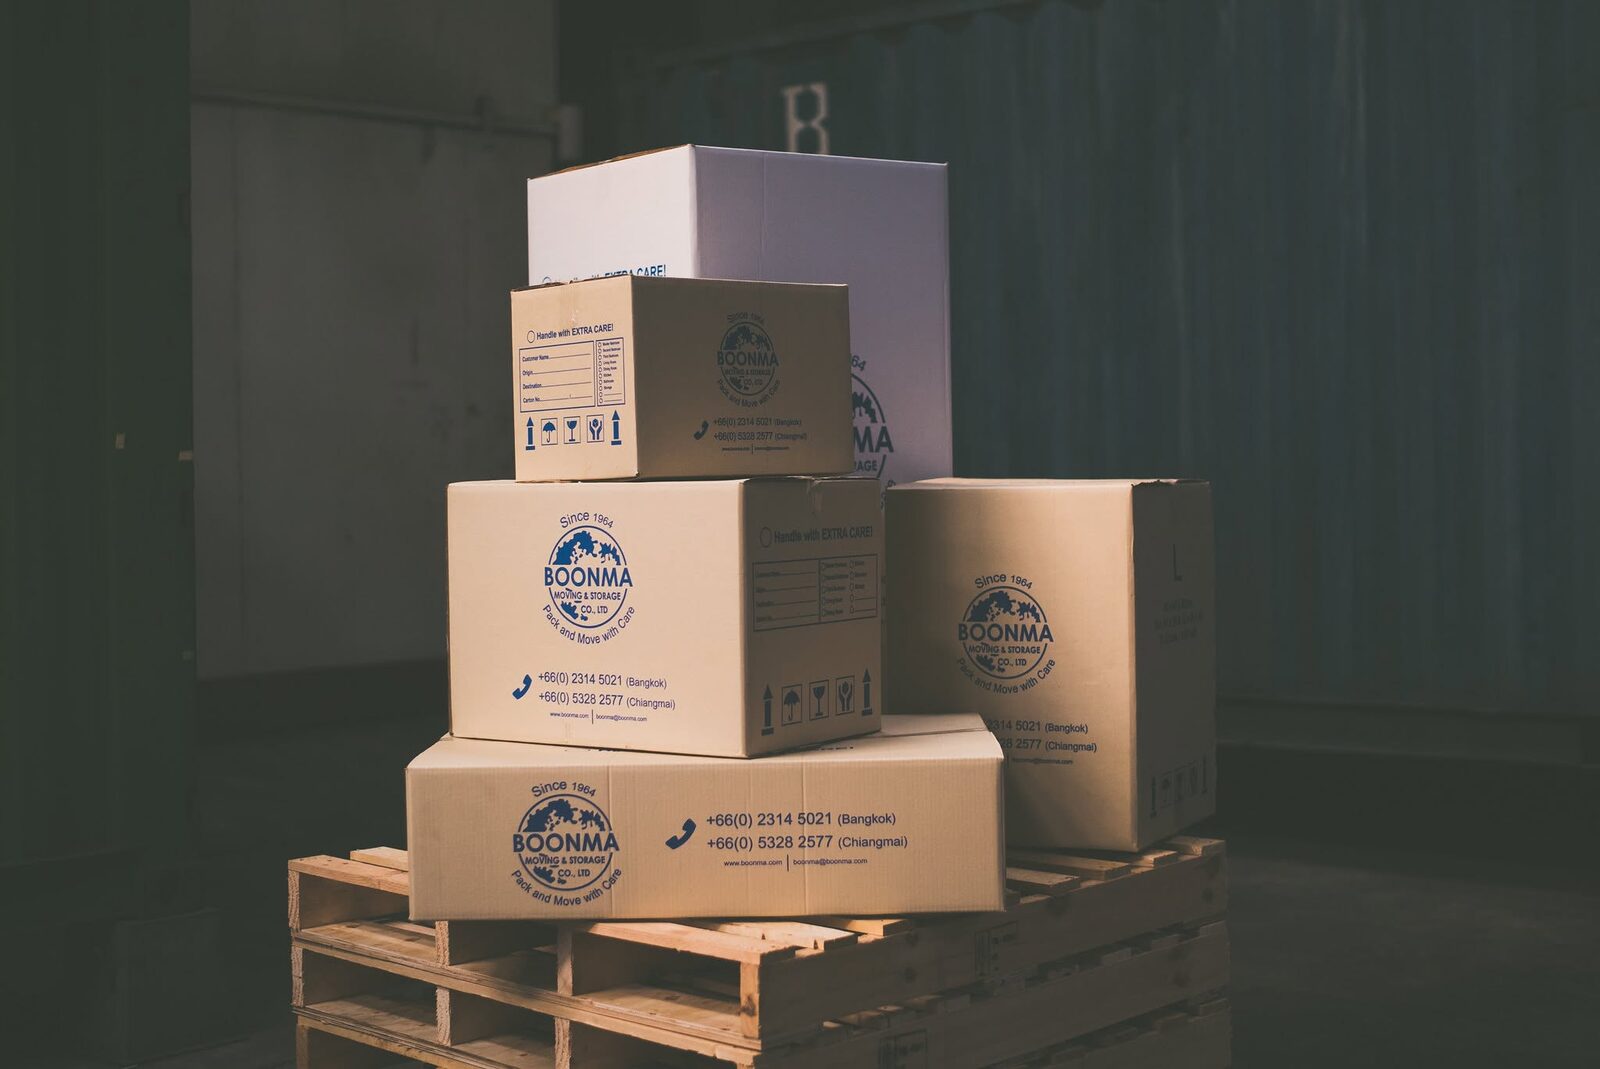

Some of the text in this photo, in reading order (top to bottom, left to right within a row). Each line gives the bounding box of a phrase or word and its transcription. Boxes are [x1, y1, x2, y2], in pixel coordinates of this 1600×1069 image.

[536, 323, 614, 340] Handle with EXTRA CARE!
[717, 351, 779, 366] BOONMA
[713, 418, 736, 428] +66(0)
[737, 418, 754, 426] 2314
[756, 418, 772, 426] 5021
[714, 432, 736, 442] +66(0)
[738, 432, 755, 440] 5328
[756, 432, 773, 440] 2577
[854, 460, 878, 472] AGE
[560, 512, 614, 528] Since 1964
[774, 525, 873, 544] Handle with EXTRA CARE!
[544, 566, 633, 587] BOONMA
[974, 574, 1033, 590] Since 1964
[554, 592, 621, 600] MOVING & STORAGE
[581, 605, 608, 614] CO., LTD
[542, 604, 635, 645] Pack and Move with Care
[958, 623, 1054, 642] BOONMA
[968, 646, 1000, 654] MOVING
[1008, 646, 1040, 654] STORAGE
[1015, 658, 1027, 666] LTD
[538, 672, 668, 689] +66(0) 2314 5021 (Bangkok)
[956, 657, 1056, 694] Pack and Move with Care
[538, 692, 676, 710] +66(0) 5328 2577 (Chiangmai)
[596, 714, 648, 722] boonma@boonma.com
[1016, 720, 1041, 732] 5021
[1044, 722, 1088, 734] (Bangkok)
[1016, 738, 1042, 749] 2577
[1045, 740, 1097, 752] (Chiangmai)
[532, 781, 597, 798] Since 1964
[706, 812, 896, 830] +66(0) 2314 5021 (Bangkok)
[512, 832, 620, 852] BOONMA
[706, 835, 908, 852] +66(0) 5328 2577 (Chiangmai)
[525, 856, 560, 864] MOVING
[569, 856, 606, 864] STORAGE
[724, 858, 868, 867] www.boonma.com boonma@boonma.com
[558, 868, 591, 878] CO., LTD
[512, 868, 622, 906] Pack and Move with Care
